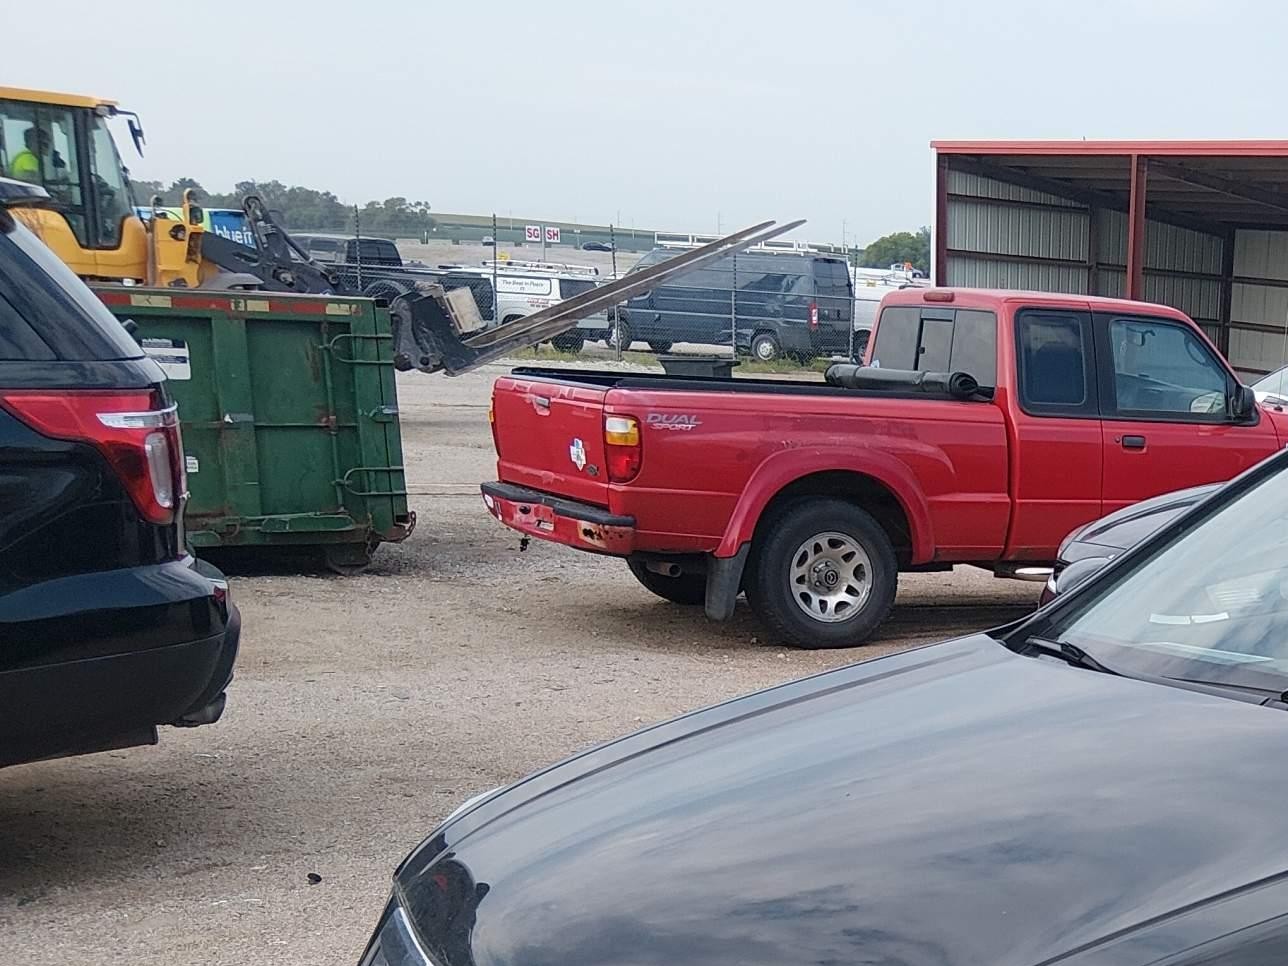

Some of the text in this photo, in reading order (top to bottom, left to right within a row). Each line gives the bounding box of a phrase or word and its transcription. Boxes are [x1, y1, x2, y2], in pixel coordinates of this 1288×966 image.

[526, 227, 540, 239] SG
[546, 229, 559, 241] SH
[646, 413, 704, 424] DUAL
[650, 422, 697, 431] SPORT
